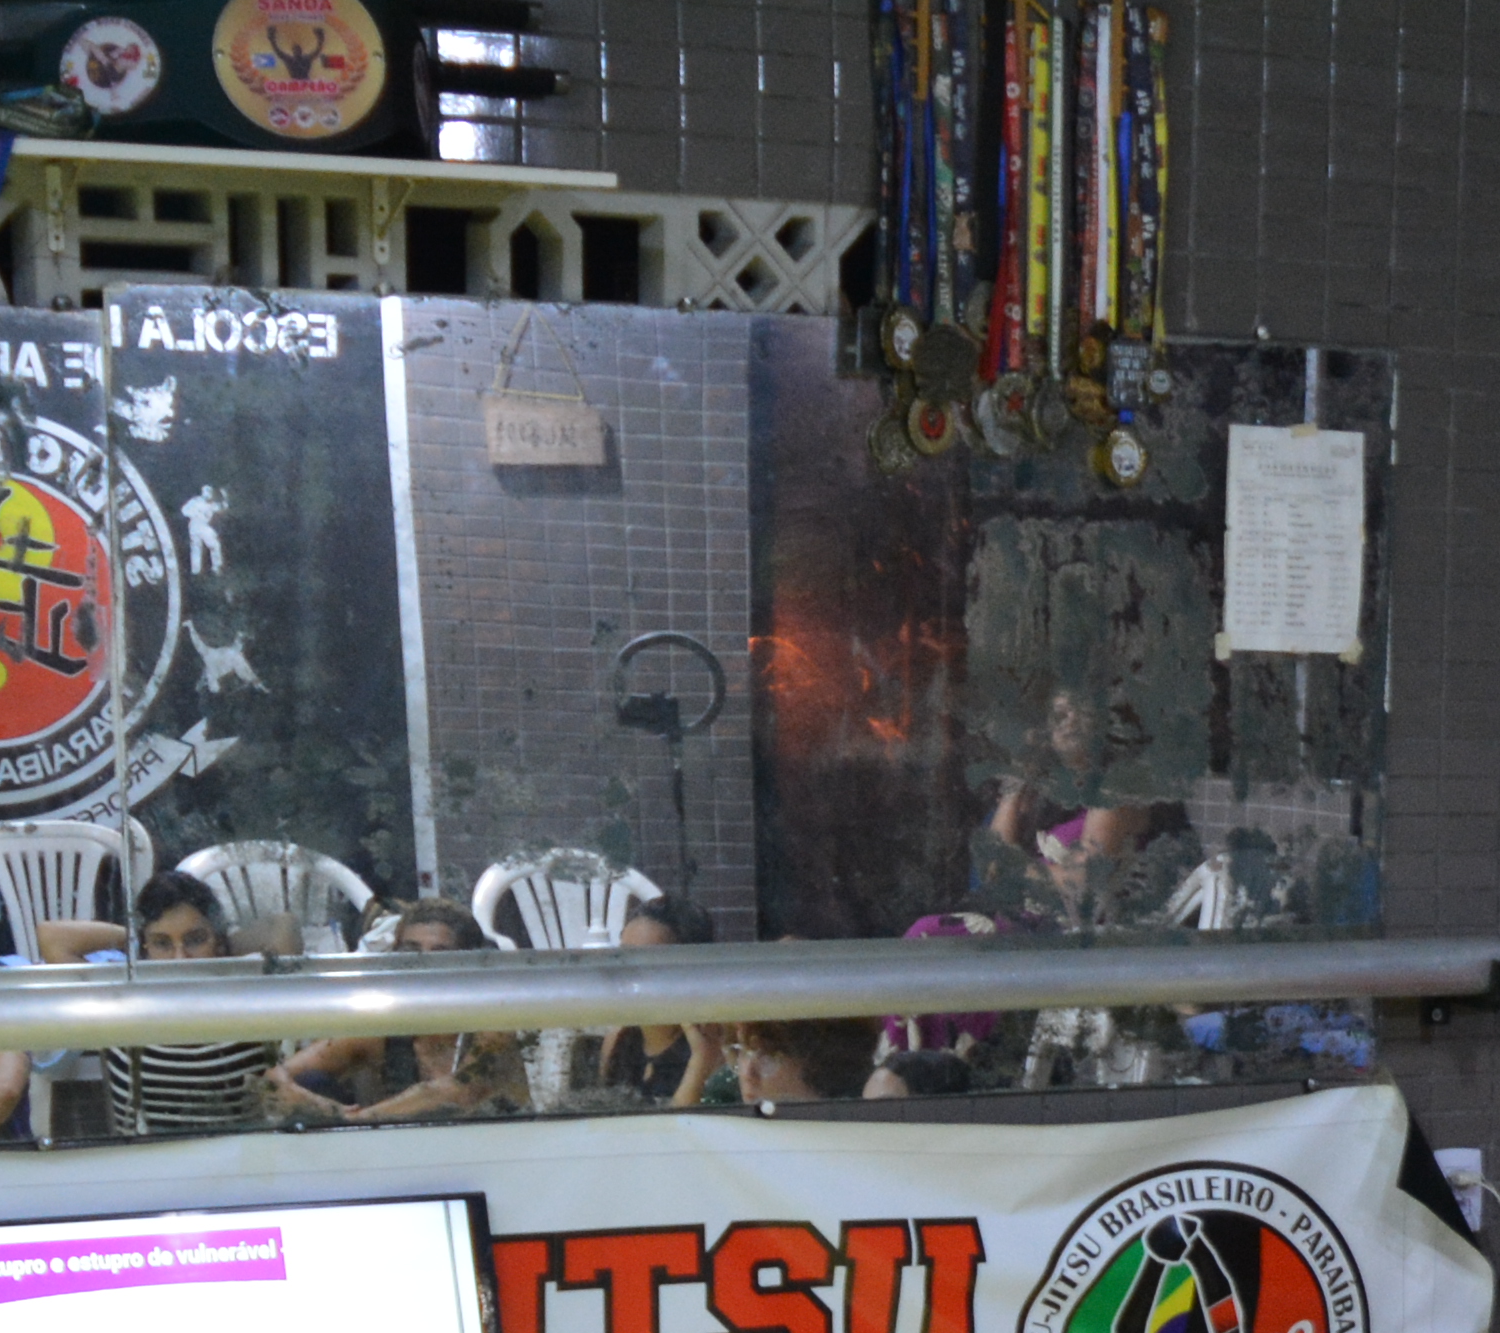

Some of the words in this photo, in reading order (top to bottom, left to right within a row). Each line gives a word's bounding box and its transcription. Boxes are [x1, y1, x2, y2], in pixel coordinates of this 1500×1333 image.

[1097, 1176, 1275, 1240] BRASILEIRO
[50, 1258, 65, 1274] e
[67, 1249, 145, 1276] estupro
[147, 1245, 174, 1268] de
[176, 1238, 277, 1266] vulnerável
